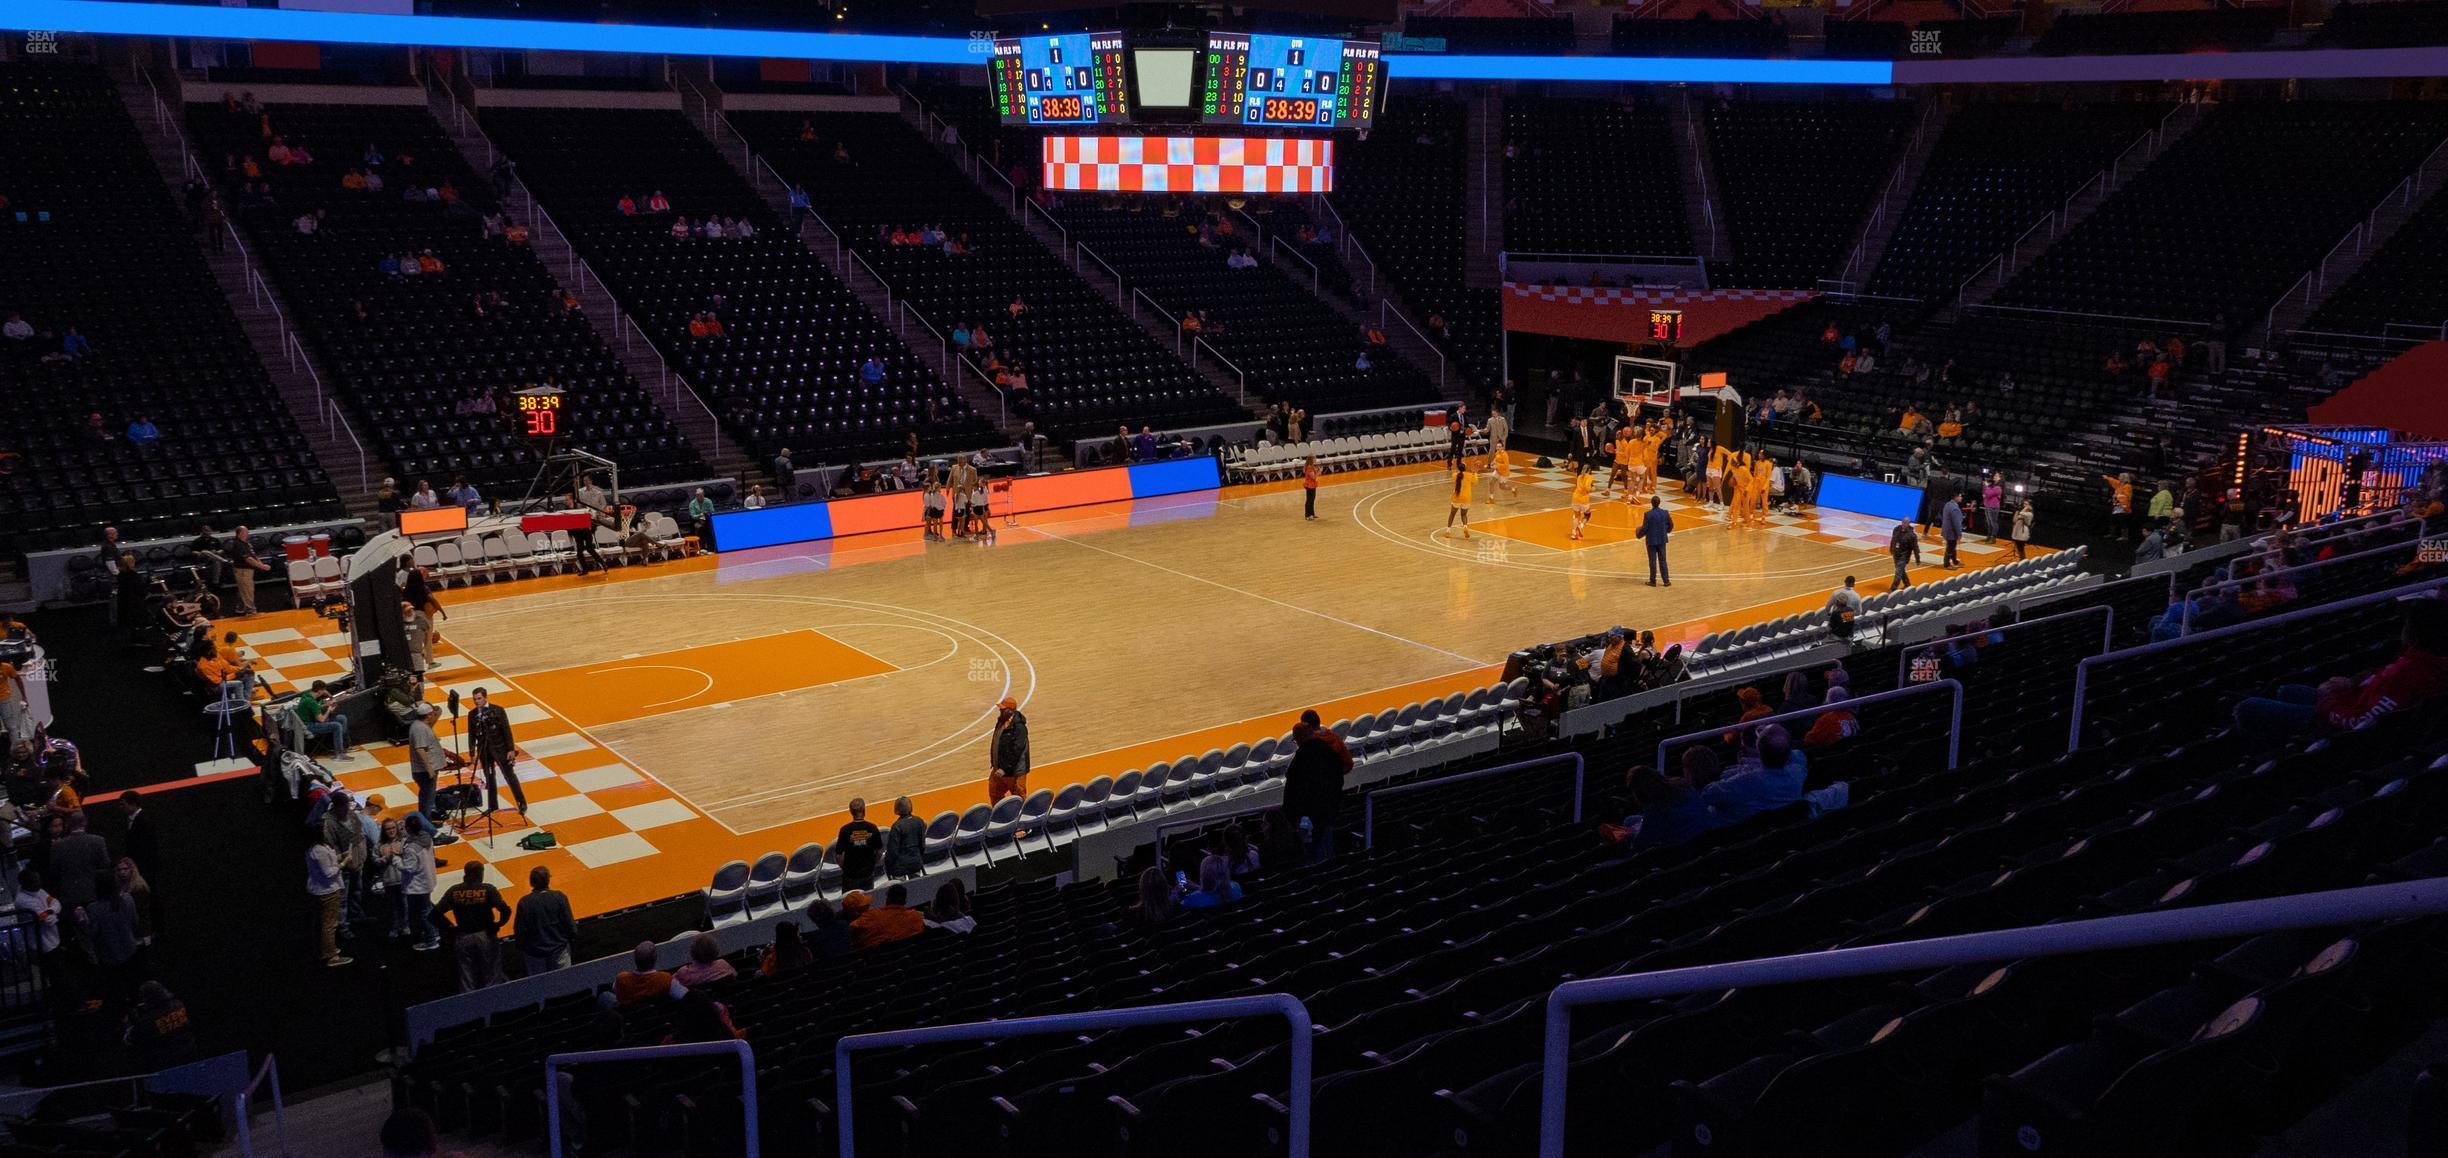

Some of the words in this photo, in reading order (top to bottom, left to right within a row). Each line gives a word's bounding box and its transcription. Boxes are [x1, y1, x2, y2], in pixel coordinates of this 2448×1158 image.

[1112, 40, 1122, 49] PTS
[1209, 40, 1222, 49] PLR
[1223, 41, 1236, 50] FLS
[1237, 41, 1249, 50] PTS
[1291, 40, 1303, 48] QTR
[1054, 49, 1059, 63] 1
[1294, 51, 1299, 64] 1
[1343, 48, 1354, 57] PLR
[1356, 49, 1366, 58] FLS
[1367, 49, 1378, 59] PTS
[996, 60, 1004, 69] 00
[1016, 59, 1021, 68] 9
[1095, 55, 1100, 65] 3
[1105, 54, 1111, 63] 0
[1115, 53, 1120, 63] 0
[1209, 55, 1220, 64] 00
[1238, 55, 1245, 65] 9
[1095, 68, 1103, 77] 11
[1107, 66, 1112, 76] 0
[1116, 66, 1121, 76] 7
[1223, 67, 1230, 76] 3
[1235, 68, 1246, 77] 17
[1344, 62, 1349, 71] 3
[1357, 62, 1363, 71] 0
[1367, 62, 1374, 72] 0
[1016, 71, 1023, 80] 17
[1277, 68, 1284, 77] TO
[1304, 69, 1312, 78] TO
[1031, 73, 1038, 88] 0
[1066, 78, 1072, 88] 4
[1080, 71, 1087, 86] 0
[1095, 80, 1104, 89] 20
[1108, 78, 1113, 88] 2
[1117, 79, 1123, 88] 7
[1257, 72, 1265, 87] 0
[1321, 75, 1330, 91] 0
[1341, 74, 1349, 83] 11
[1356, 74, 1361, 83] 0
[1366, 75, 1372, 84] 7
[999, 82, 1006, 92] 13
[1018, 82, 1023, 91] 8
[1046, 79, 1052, 89] 4
[1208, 80, 1218, 89] 13
[1236, 80, 1242, 89] 8
[1276, 80, 1283, 90] 4
[1303, 80, 1310, 91] 4
[1340, 86, 1349, 94] 20
[1355, 86, 1360, 94] 2
[1365, 86, 1371, 95] 7
[1000, 94, 1008, 103] 23
[1018, 93, 1026, 103] 10
[1096, 92, 1105, 102] 21
[1118, 91, 1124, 101] 2
[1206, 92, 1217, 101] 23
[1233, 93, 1243, 102] 10
[1249, 97, 1261, 106] FLS
[1321, 100, 1332, 108] FLS
[1337, 97, 1347, 106] 21
[1363, 98, 1370, 107] 2
[1001, 105, 1009, 115] 33
[1011, 105, 1016, 114] 0
[1020, 105, 1026, 115] 0
[1042, 98, 1080, 117] 38:39
[1098, 104, 1107, 113] 24
[1111, 103, 1116, 113] 0
[1120, 103, 1125, 113] 0
[1205, 104, 1216, 114] 33
[1220, 104, 1226, 114] 0
[1234, 105, 1240, 115] 0
[1265, 99, 1316, 119] 38:39
[1032, 108, 1038, 118] 0
[1086, 108, 1092, 118] 0
[1250, 109, 1257, 120] 0
[1321, 111, 1328, 121] 0
[1337, 109, 1347, 118] 24
[1352, 109, 1357, 118] 0
[1362, 109, 1368, 119] 0
[1651, 313, 1672, 323] 38:39
[1653, 323, 1668, 339] 30
[519, 396, 559, 410] 38:39
[526, 410, 555, 433] 30
[452, 889, 487, 898] EVENT
